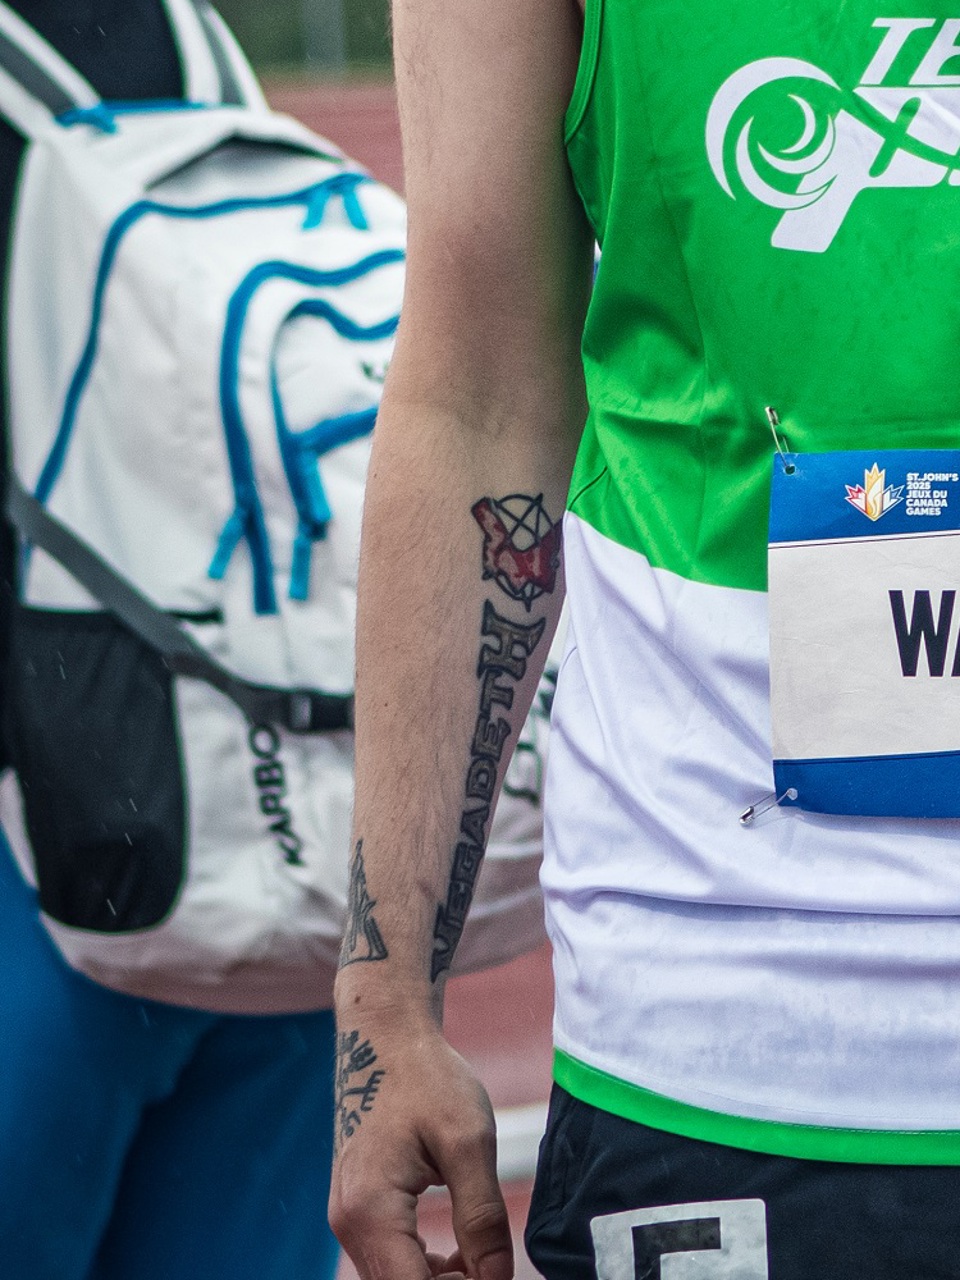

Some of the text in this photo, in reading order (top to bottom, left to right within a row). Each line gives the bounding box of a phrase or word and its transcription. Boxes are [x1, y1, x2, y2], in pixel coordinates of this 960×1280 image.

[906, 481, 931, 490] 2025
[906, 489, 948, 499] JEUX DU
[905, 498, 948, 508] CANADA
[905, 506, 942, 516] GAMES
